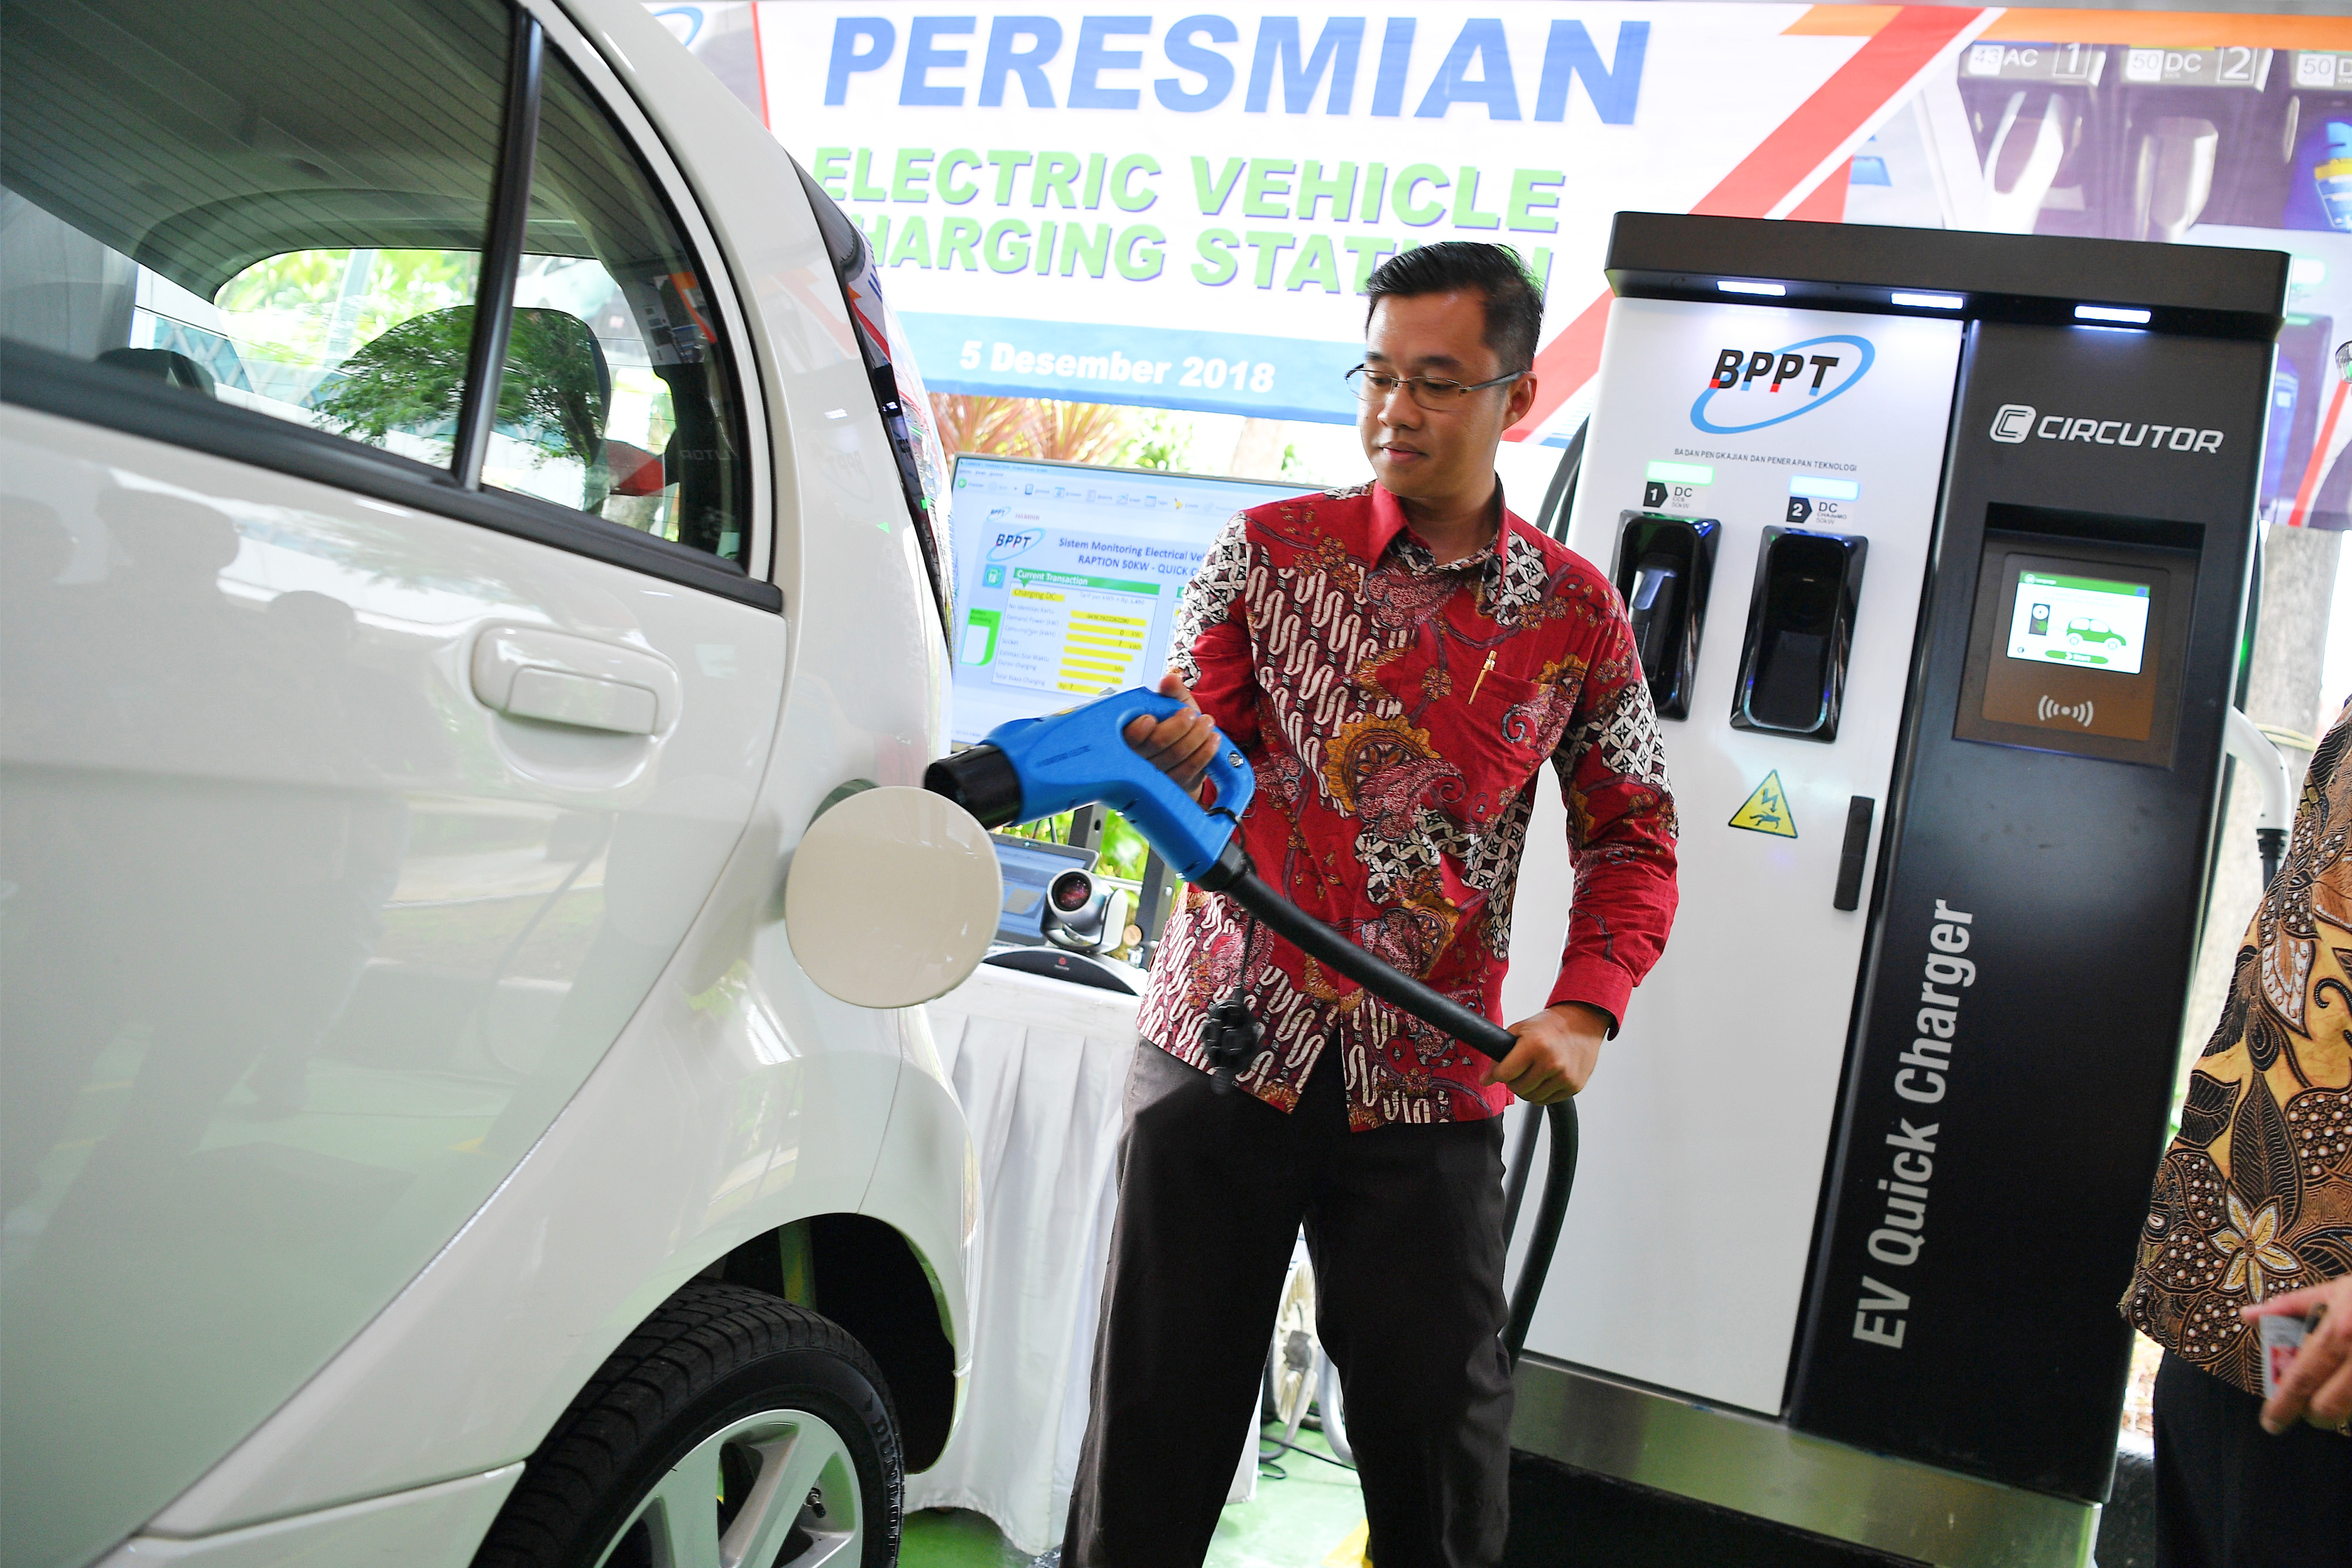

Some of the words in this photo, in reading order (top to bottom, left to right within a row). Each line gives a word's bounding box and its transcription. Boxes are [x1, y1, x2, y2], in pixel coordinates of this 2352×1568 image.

[2003, 48, 2039, 68] AC
[2132, 51, 2161, 69] 50
[2164, 52, 2202, 73] DC
[2222, 46, 2251, 79] 2
[2303, 58, 2331, 75] 50
[823, 15, 1651, 125] PERESMIAN
[813, 147, 1162, 213] ELECTRIC
[1190, 156, 1566, 233] VEHICLE
[852, 213, 1167, 282] HARGING
[1190, 227, 1553, 307] STAT
[961, 339, 983, 370] 5
[990, 342, 1171, 384] Desember
[1178, 356, 1276, 393] 2018
[1709, 348, 1840, 397] BPPT
[2037, 413, 2224, 455] CIRCUTOR
[1675, 448, 1700, 457] BADAN
[1700, 450, 1748, 462] PENGKAJIAN
[1767, 457, 1812, 467] PENERAPAN
[1814, 460, 1857, 472] TEKNOLOGI
[1650, 488, 1659, 502] 1
[1675, 486, 1693, 497] DC
[1792, 503, 1803, 517] 2
[1819, 502, 1838, 513] DC
[995, 533, 1032, 550] BPPT
[1059, 537, 1088, 549] Sistem
[1091, 541, 1143, 557] Monitoring
[1145, 547, 1188, 560] Electrical
[1078, 555, 1120, 568] RAPTION
[1122, 559, 1150, 571] 50KW
[1158, 564, 1188, 576] QUICK
[1017, 570, 1045, 581] Current
[1046, 573, 1088, 586] Transaction
[1014, 588, 1045, 600] Charging
[1045, 592, 1056, 600] DC
[1894, 899, 1976, 1104] Charger
[1867, 1118, 1940, 1266] Quick
[1853, 1275, 1910, 1349] EV
